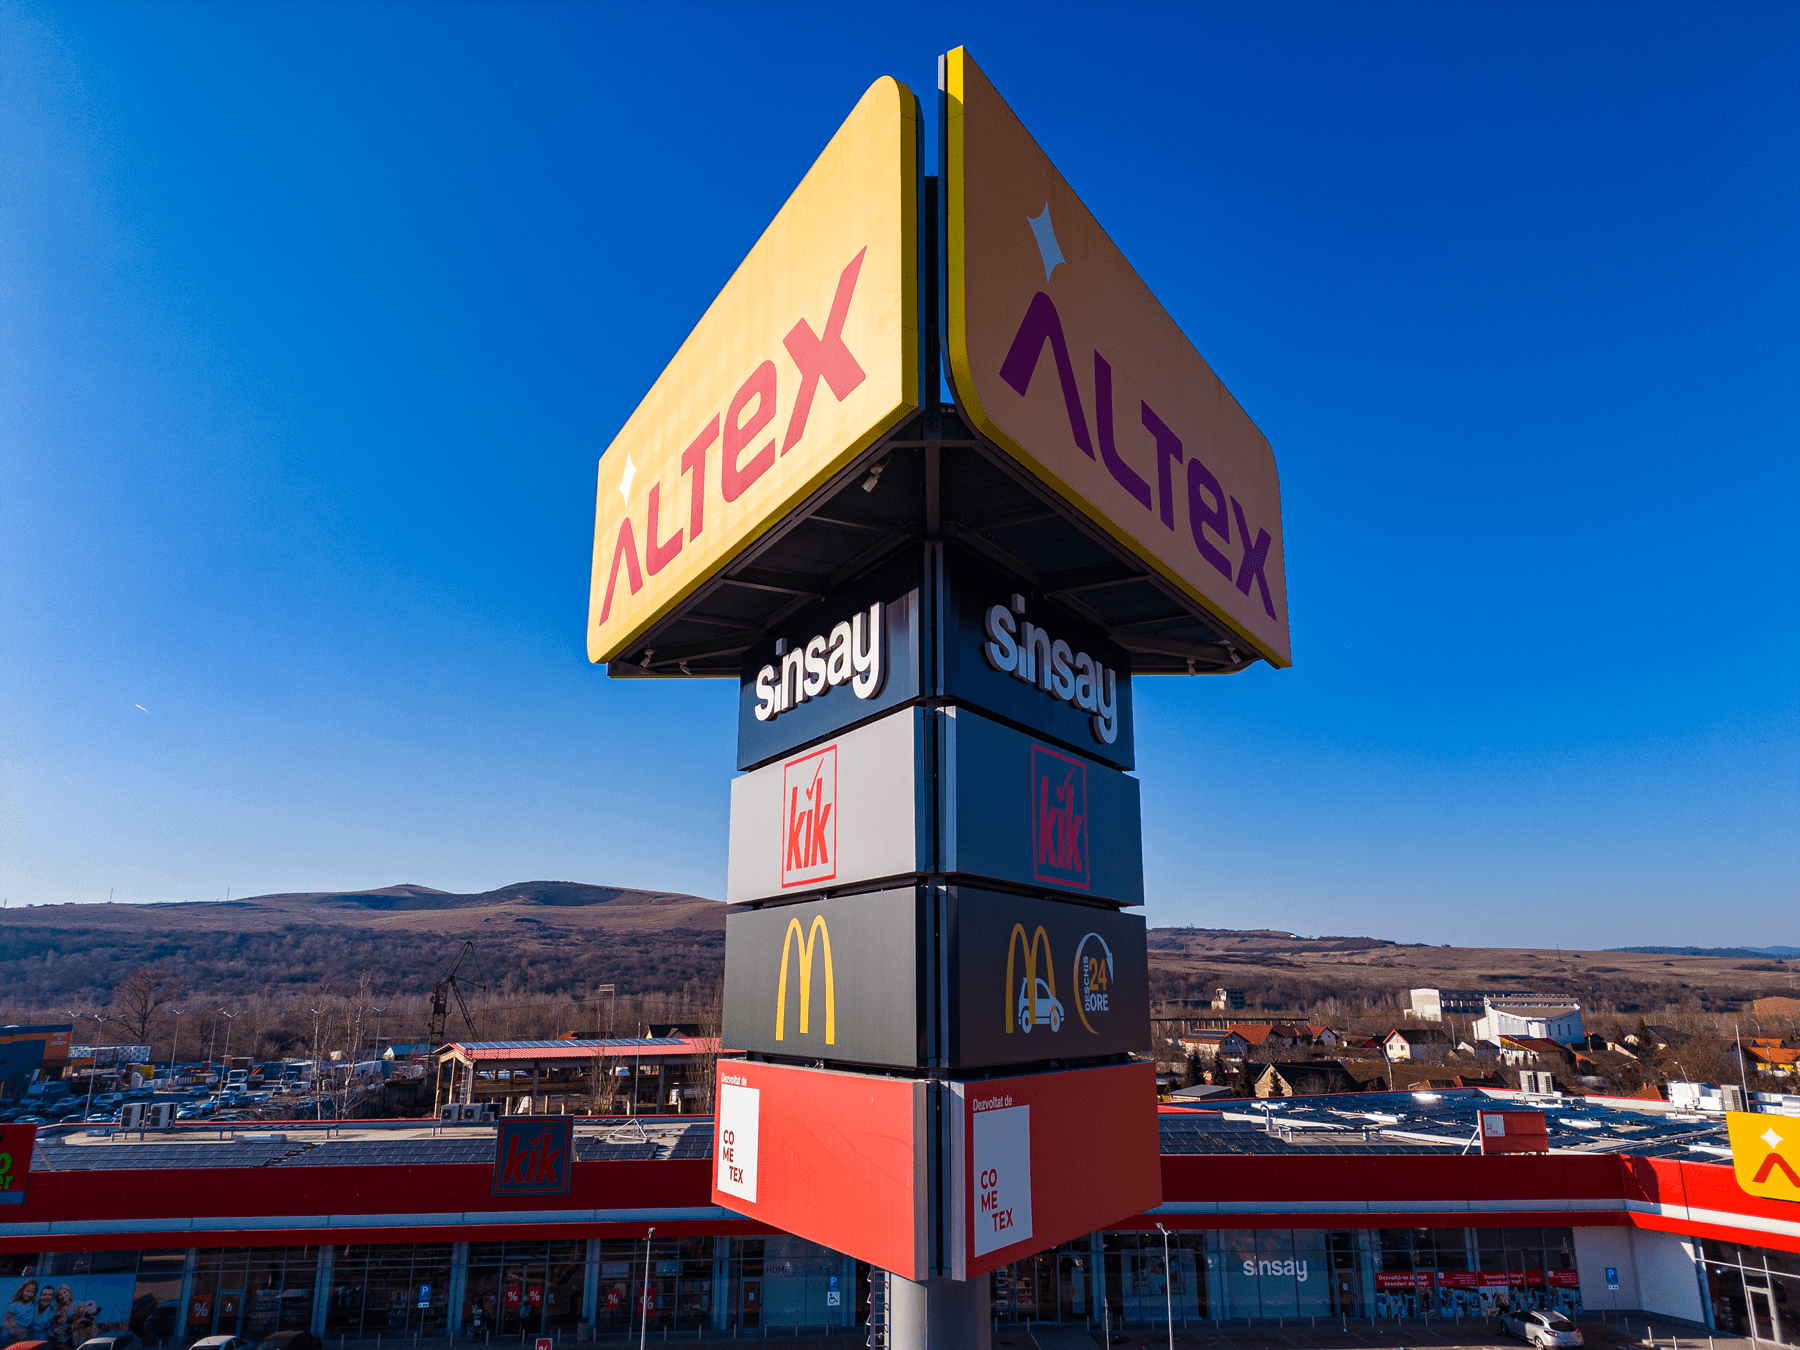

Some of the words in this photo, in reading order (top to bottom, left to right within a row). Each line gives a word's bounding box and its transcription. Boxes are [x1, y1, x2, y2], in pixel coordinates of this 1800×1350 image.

[754, 602, 886, 721] sinsay
[984, 593, 1118, 744] sinsay
[1088, 957, 1107, 991] 24
[1090, 993, 1109, 1011] ORE
[721, 1073, 741, 1086] Dezvoltat
[741, 1076, 747, 1086] de
[973, 1096, 1003, 1111] Dezvoltat
[1004, 1095, 1012, 1106] de
[723, 1129, 735, 1146] CO
[502, 1123, 563, 1184] kik
[722, 1146, 734, 1163] ME
[729, 1165, 743, 1184] TEX
[980, 1168, 997, 1190] CO
[981, 1190, 998, 1213] ME
[991, 1208, 1014, 1232] TEX
[1243, 1255, 1308, 1282] sinsay
